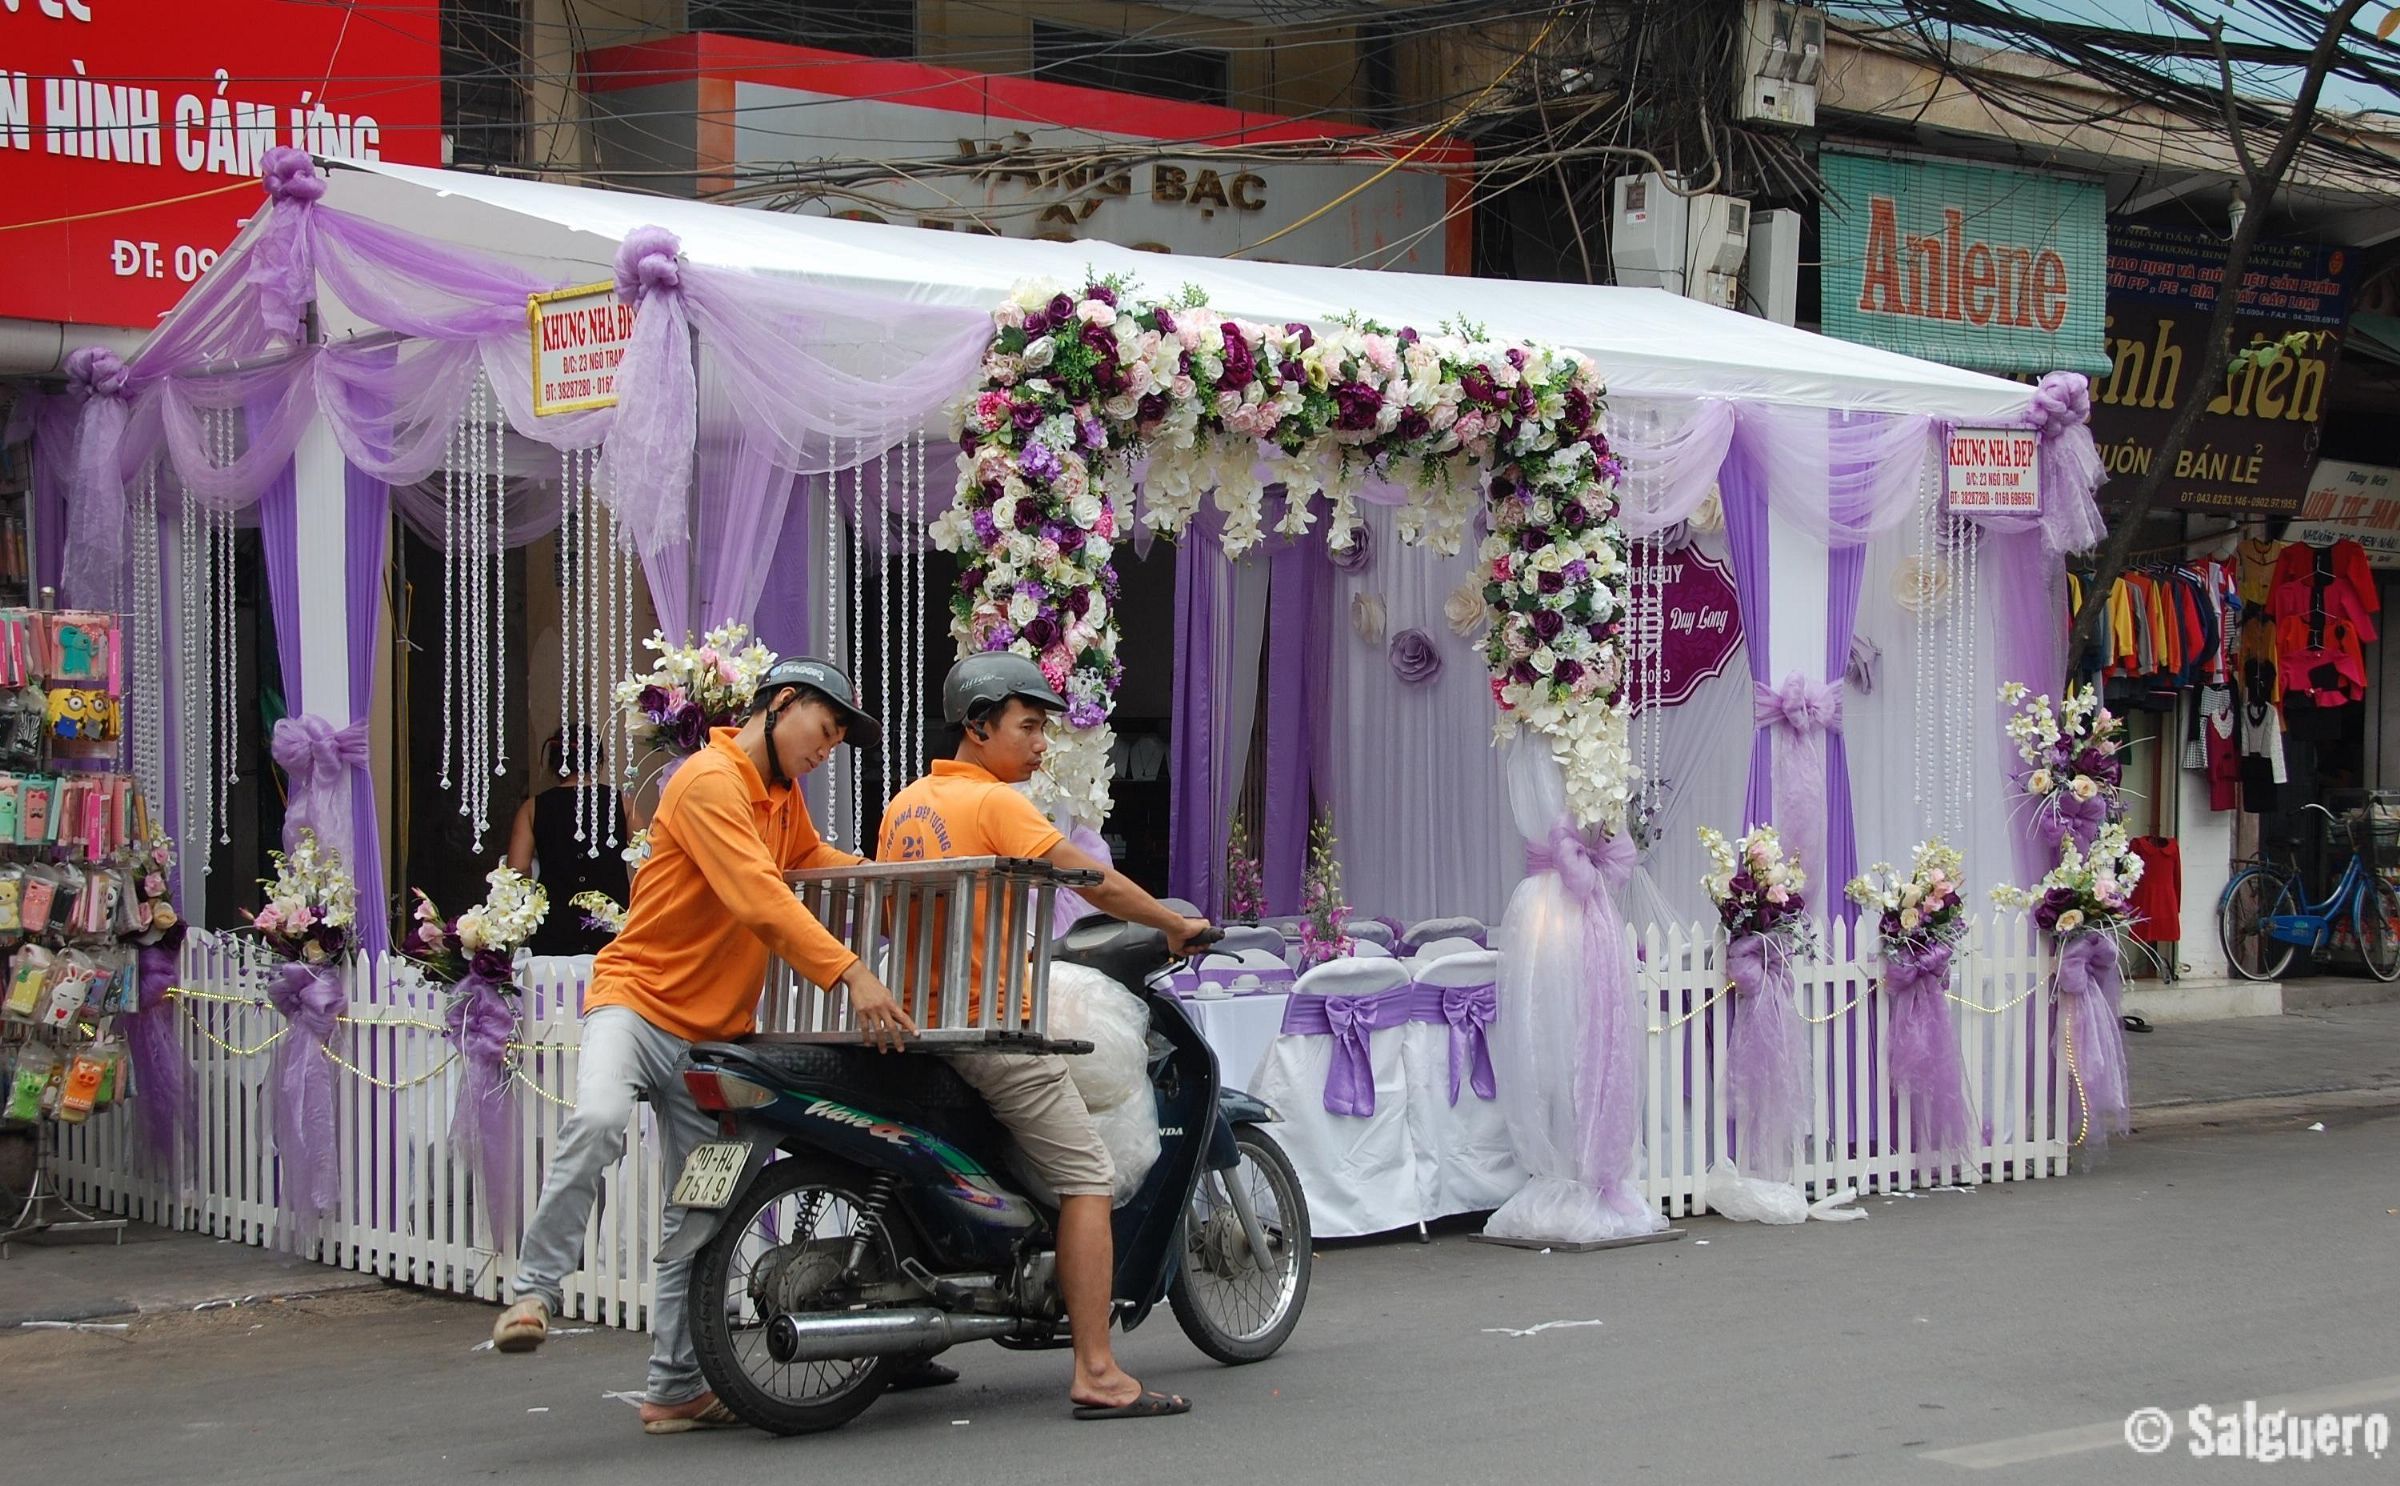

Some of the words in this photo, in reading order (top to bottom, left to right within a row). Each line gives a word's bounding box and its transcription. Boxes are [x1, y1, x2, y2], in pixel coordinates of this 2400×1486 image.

[45, 59, 161, 166] HÌNH
[174, 68, 276, 178] CẢM
[1151, 163, 1268, 218] BẠC
[111, 239, 164, 279] ĐT:
[1858, 195, 2068, 332] Anlene
[543, 309, 586, 351] KHUNG
[588, 294, 616, 345] NHÀ
[579, 354, 588, 372] 23
[1949, 438, 1986, 466] KHUNG
[1989, 425, 2012, 467] NHÀ
[2175, 443, 2229, 481] BÁN
[2231, 443, 2264, 484] LẺ
[1980, 472, 1987, 486] 23
[1670, 607, 1696, 635] Duy
[1697, 605, 1729, 634] Long
[902, 835, 925, 859] 23
[804, 1100, 874, 1129] Wave
[1158, 1127, 1184, 1136] NDA
[691, 1146, 739, 1173] 90-H4
